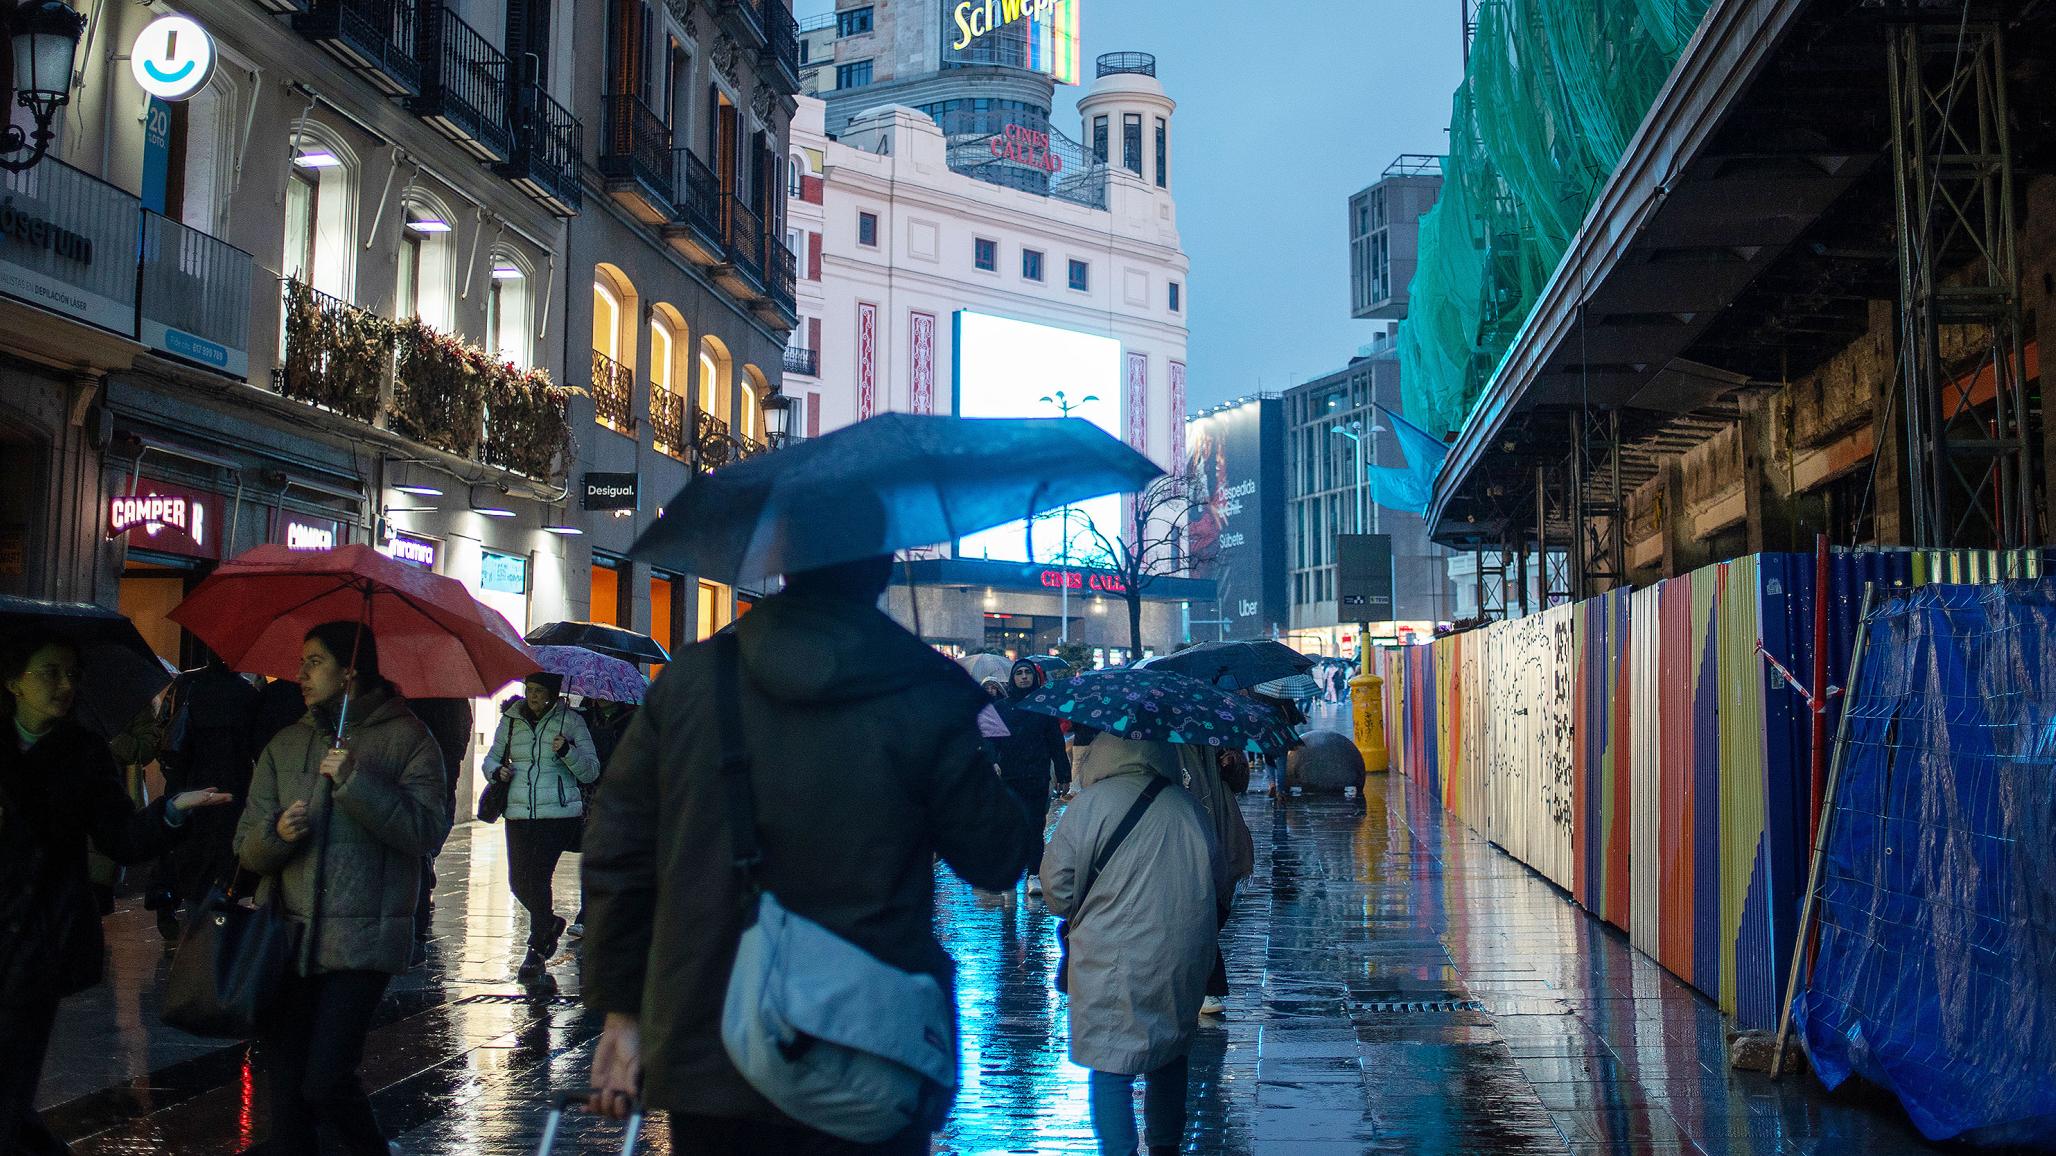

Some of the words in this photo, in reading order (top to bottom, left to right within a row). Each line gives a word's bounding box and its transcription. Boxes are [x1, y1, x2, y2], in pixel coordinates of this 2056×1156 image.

[149, 106, 167, 136] 20
[1006, 124, 1049, 149] CINES
[991, 137, 1063, 172] CALLAO
[588, 485, 635, 498] Desigual.
[1218, 478, 1256, 502] Despedida
[112, 499, 185, 528] CAMPER
[1041, 570, 1082, 589] CINES
[1089, 574, 1127, 592] CALL
[1239, 599, 1257, 617] Uber
